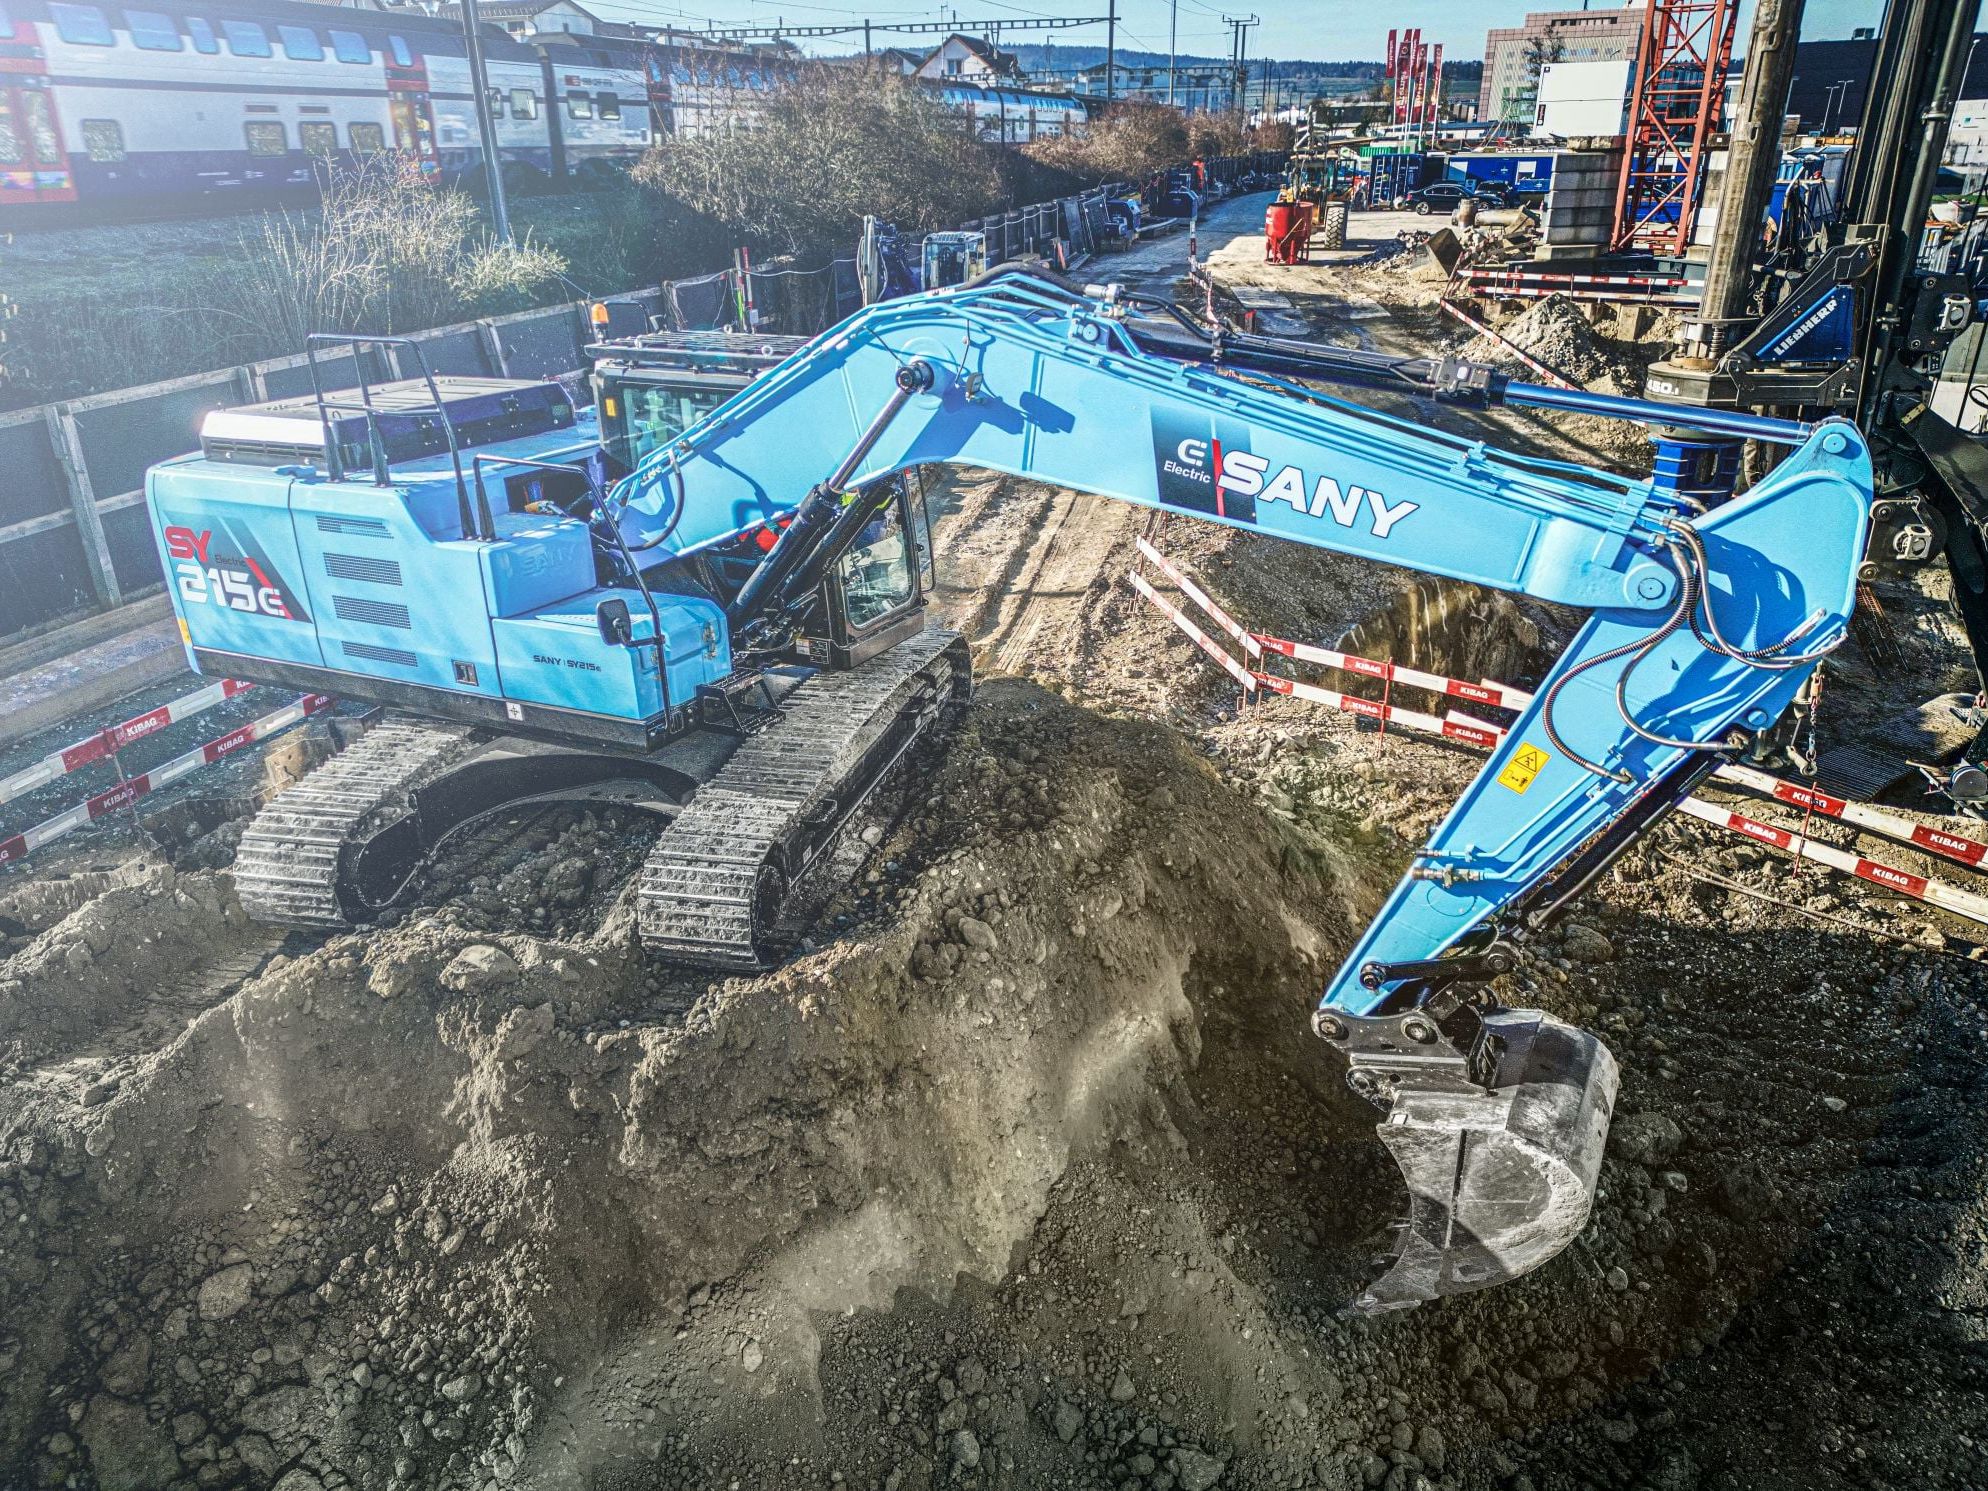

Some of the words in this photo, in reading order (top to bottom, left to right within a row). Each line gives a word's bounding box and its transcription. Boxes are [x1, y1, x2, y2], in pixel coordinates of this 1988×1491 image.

[1773, 299, 1838, 356] LIEBHERR
[1163, 459, 1211, 483] Electric
[1217, 450, 1420, 539] SANY
[164, 526, 212, 563] SY
[533, 654, 561, 666] SANY
[1354, 661, 1381, 674] KIBAG
[1459, 686, 1489, 699] KIBAG
[1351, 701, 1378, 714] KIBAG
[126, 717, 158, 737] KIBAG
[1455, 727, 1483, 741] KIBAG
[216, 735, 245, 754] KIBAG
[1743, 822, 1778, 841] KIBAG
[1930, 833, 1967, 852] KIBAG
[1872, 867, 1909, 886] KIBAG
